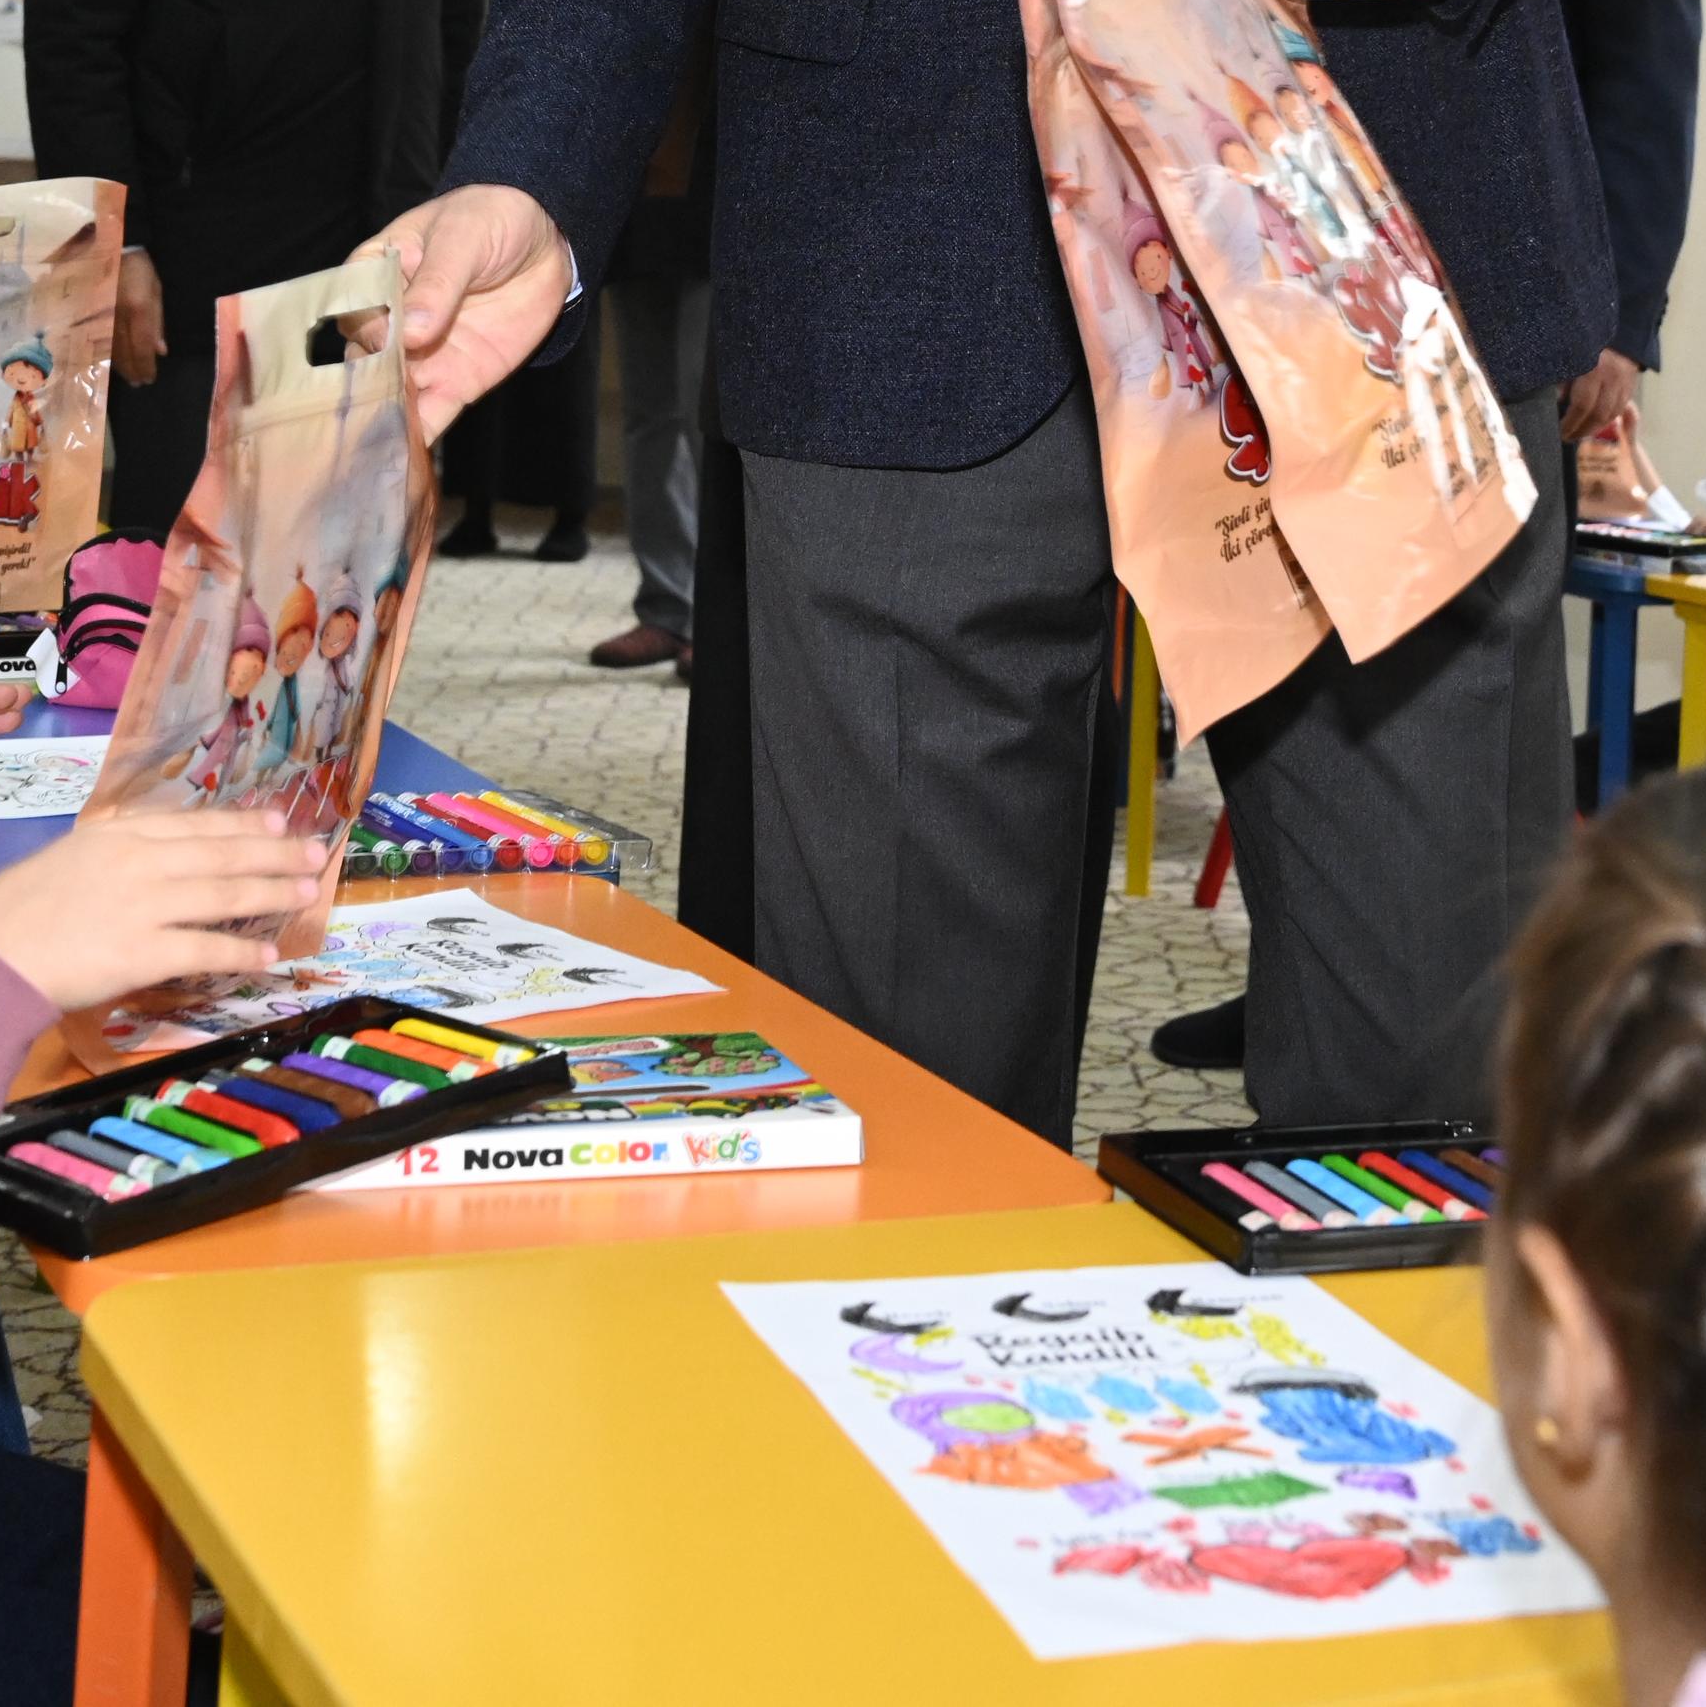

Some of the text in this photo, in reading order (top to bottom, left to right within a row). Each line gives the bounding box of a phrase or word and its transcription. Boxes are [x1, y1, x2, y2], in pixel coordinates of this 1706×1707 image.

[1255, 497, 1270, 522] şiv
[395, 1129, 762, 1176] 12 Nova Color Kid's
